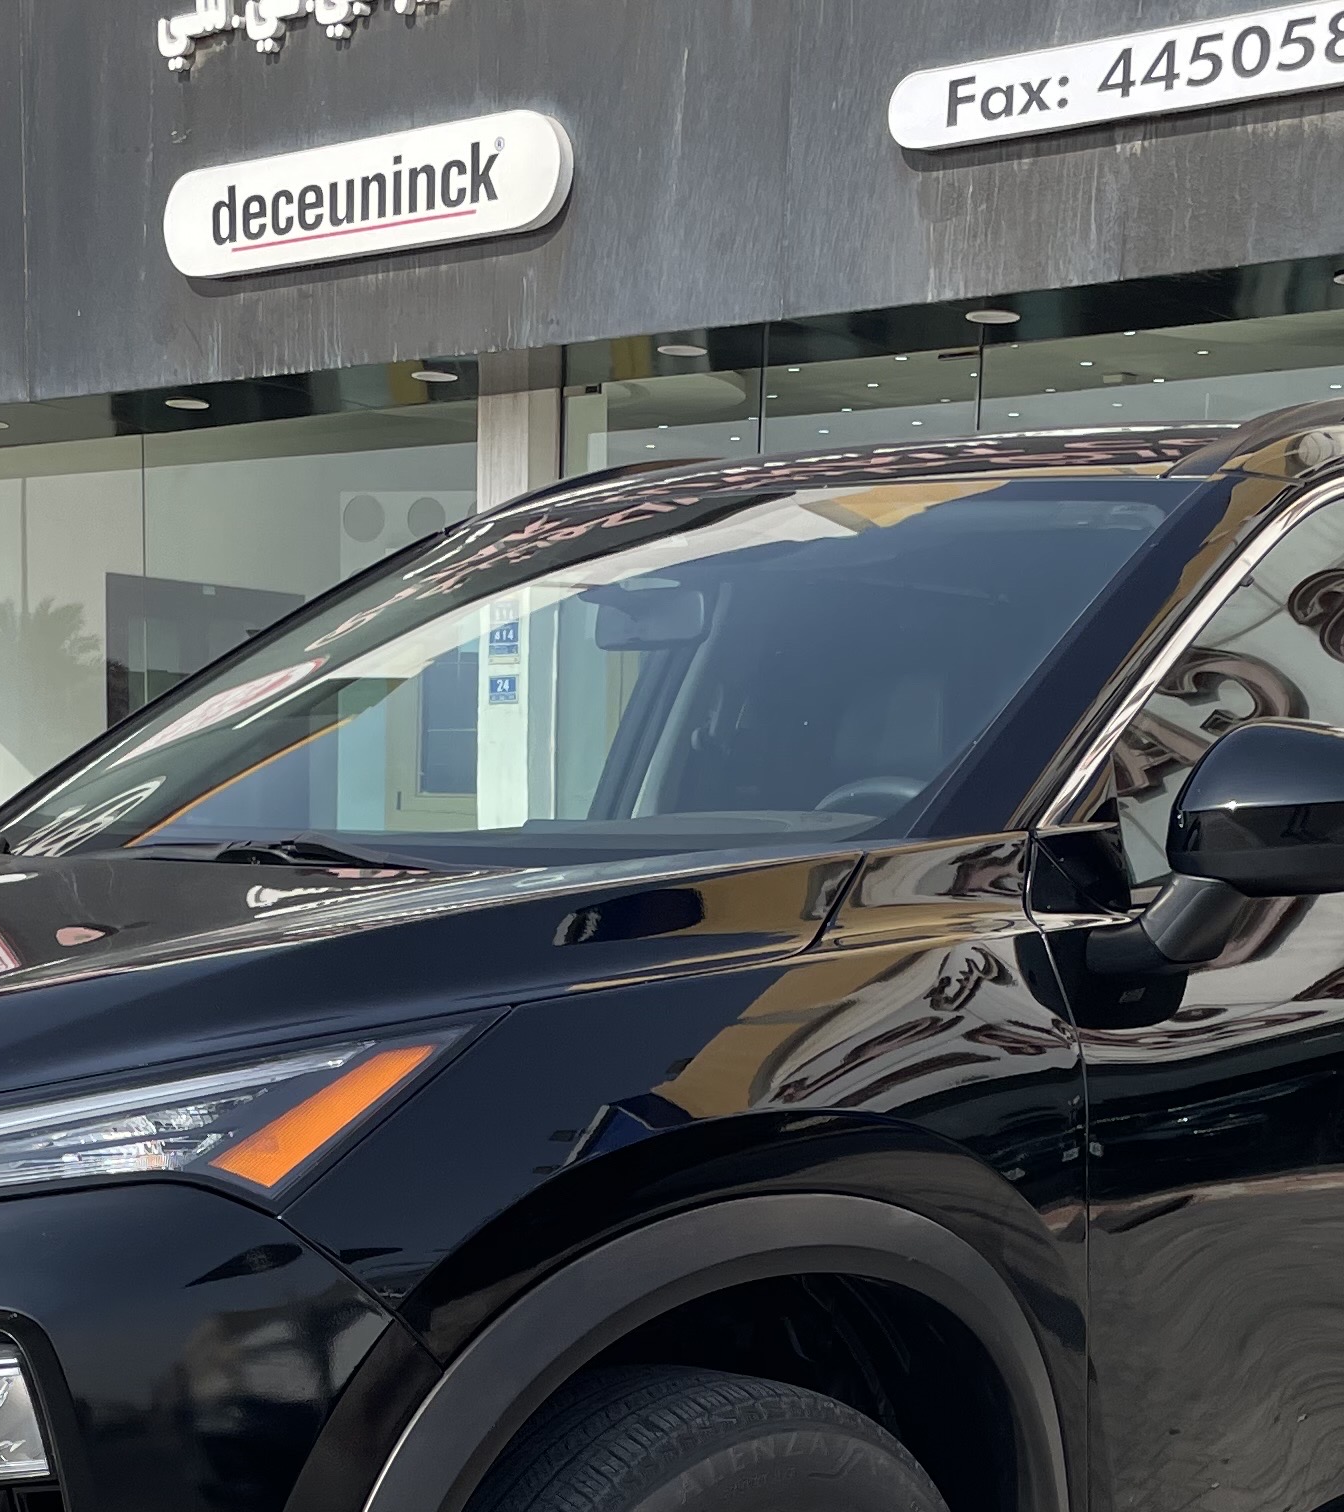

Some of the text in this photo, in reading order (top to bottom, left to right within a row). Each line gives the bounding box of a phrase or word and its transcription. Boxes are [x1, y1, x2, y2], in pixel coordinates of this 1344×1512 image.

[946, 75, 1070, 128] Fax:
[212, 141, 500, 246] deceuninck
[496, 679, 510, 692] 24
